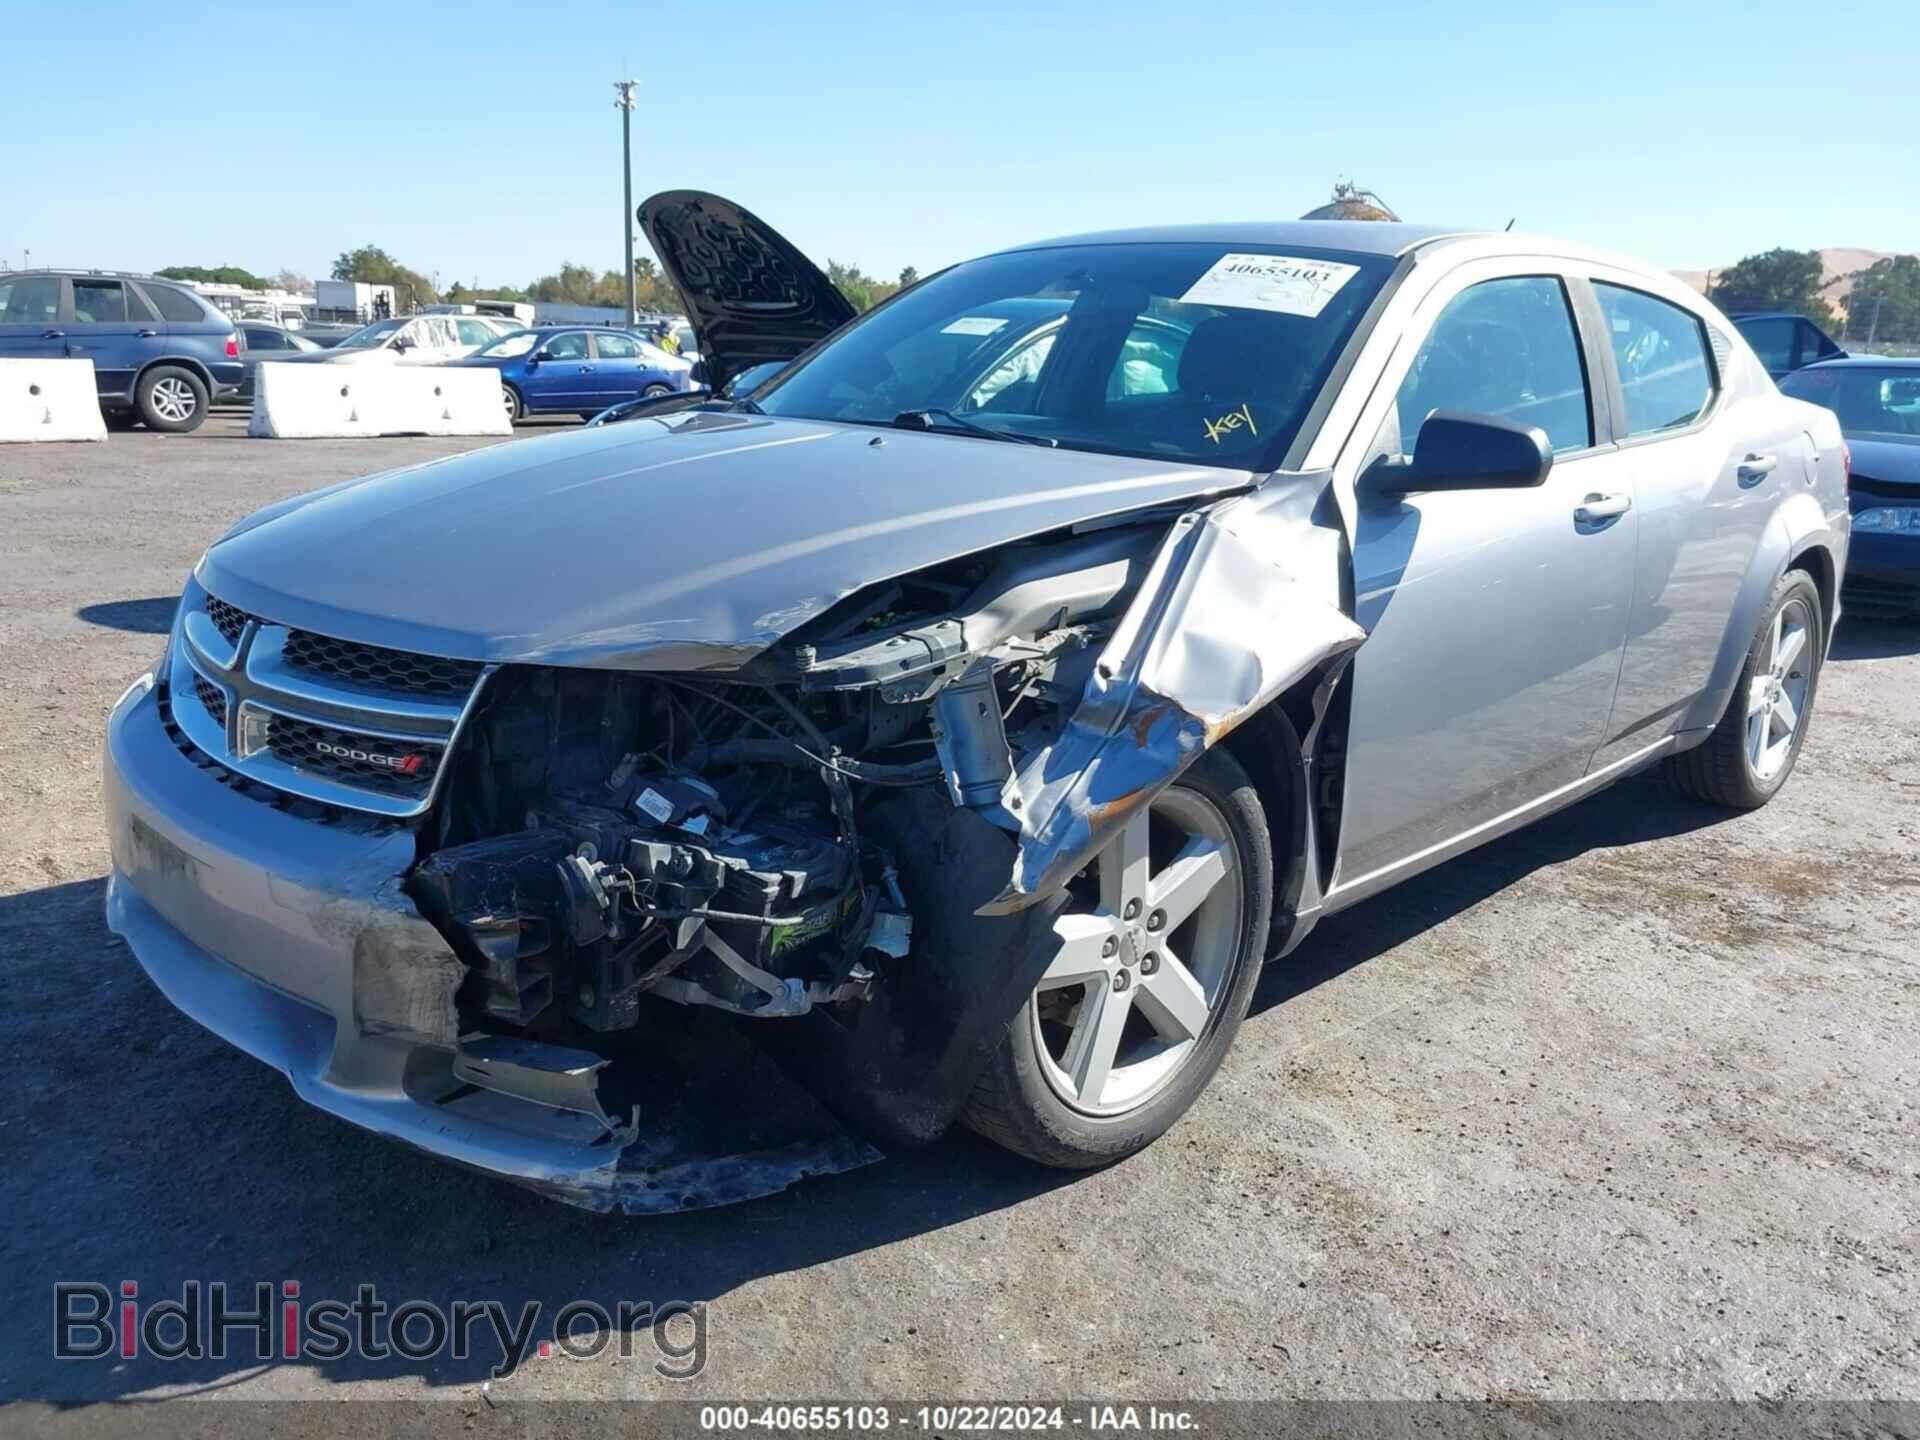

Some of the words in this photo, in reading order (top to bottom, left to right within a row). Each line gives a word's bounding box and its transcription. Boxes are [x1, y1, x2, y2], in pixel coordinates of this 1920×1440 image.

[1225, 262, 1331, 282] 40655103
[1203, 403, 1257, 444] KEY
[316, 742, 406, 768] DODGE
